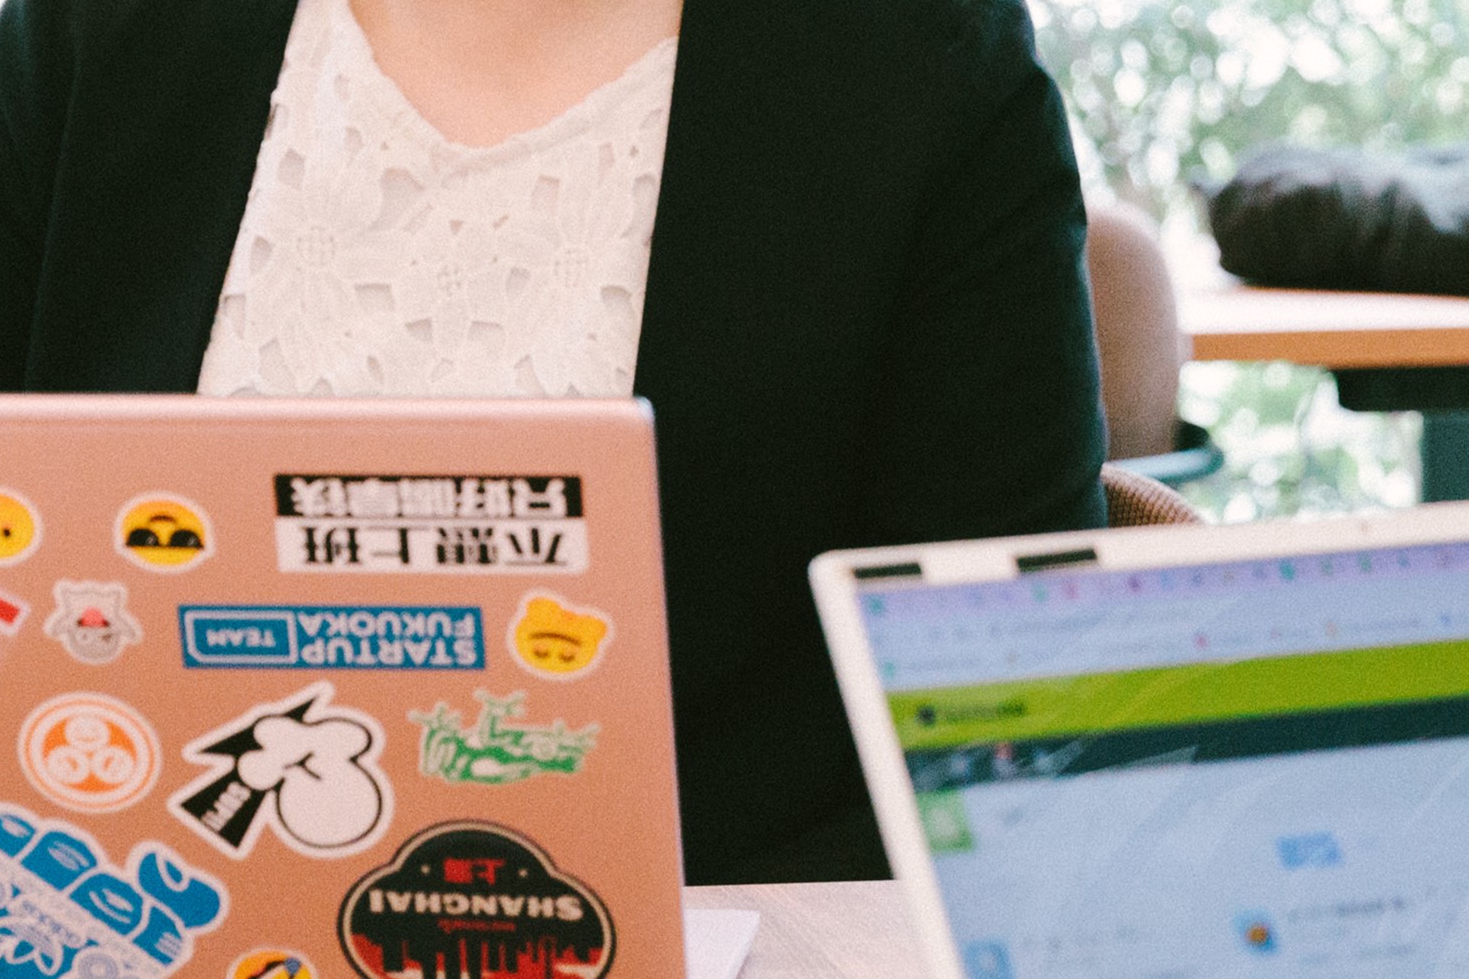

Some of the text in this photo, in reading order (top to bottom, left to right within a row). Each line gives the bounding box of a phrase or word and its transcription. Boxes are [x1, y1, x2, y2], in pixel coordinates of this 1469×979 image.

[298, 526, 568, 566] 不想上班
[205, 627, 275, 648] TEAM
[296, 609, 475, 637] FUKUOKA
[298, 635, 476, 665] STARTUP
[368, 888, 583, 920] SHANGHAI
